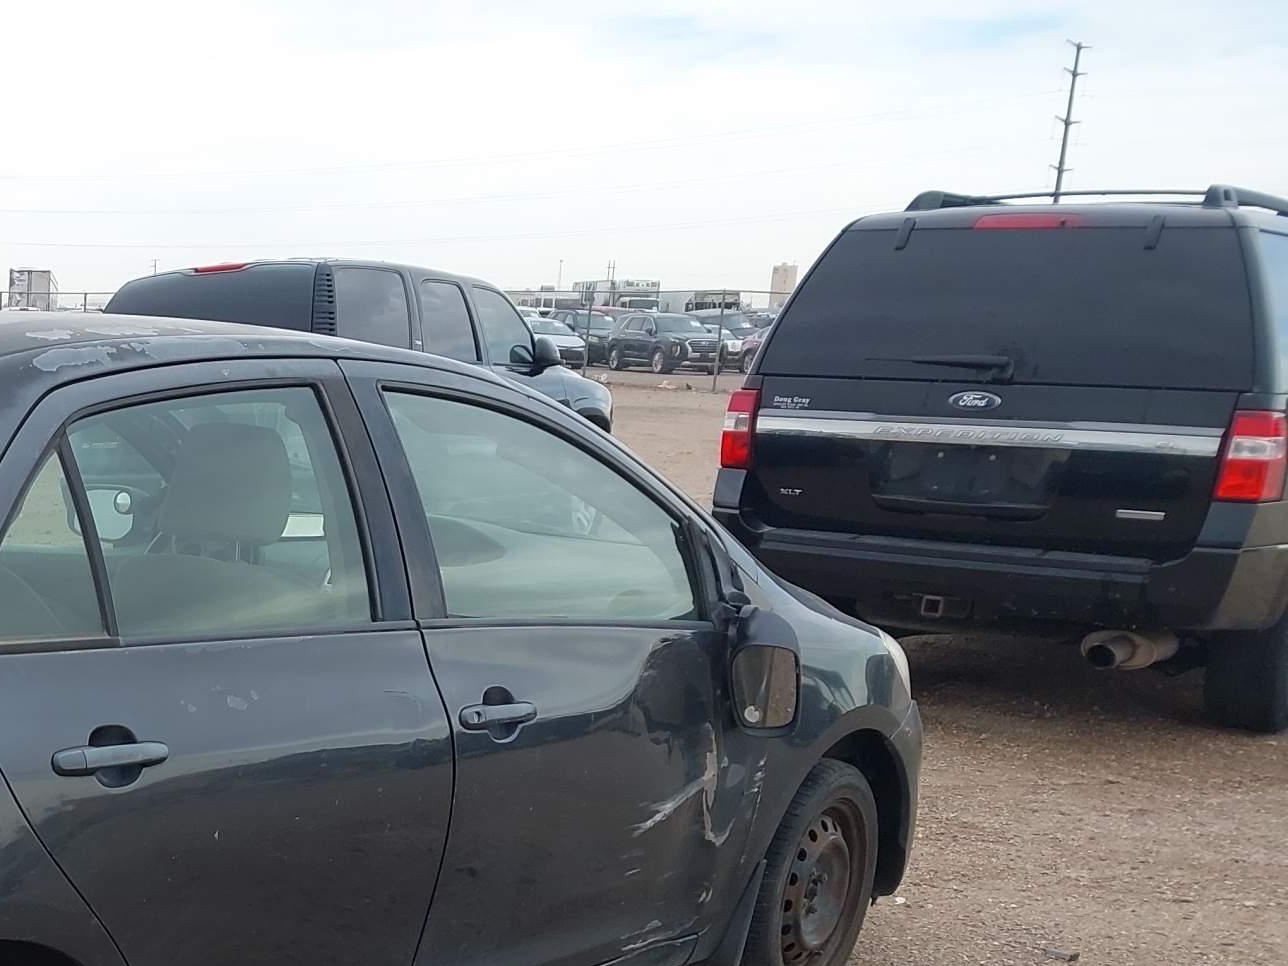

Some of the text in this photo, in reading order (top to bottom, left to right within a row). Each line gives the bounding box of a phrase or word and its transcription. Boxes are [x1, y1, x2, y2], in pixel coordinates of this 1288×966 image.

[962, 393, 989, 408] Ford
[872, 425, 1064, 443] EXPEDITION
[779, 488, 803, 496] XLT
